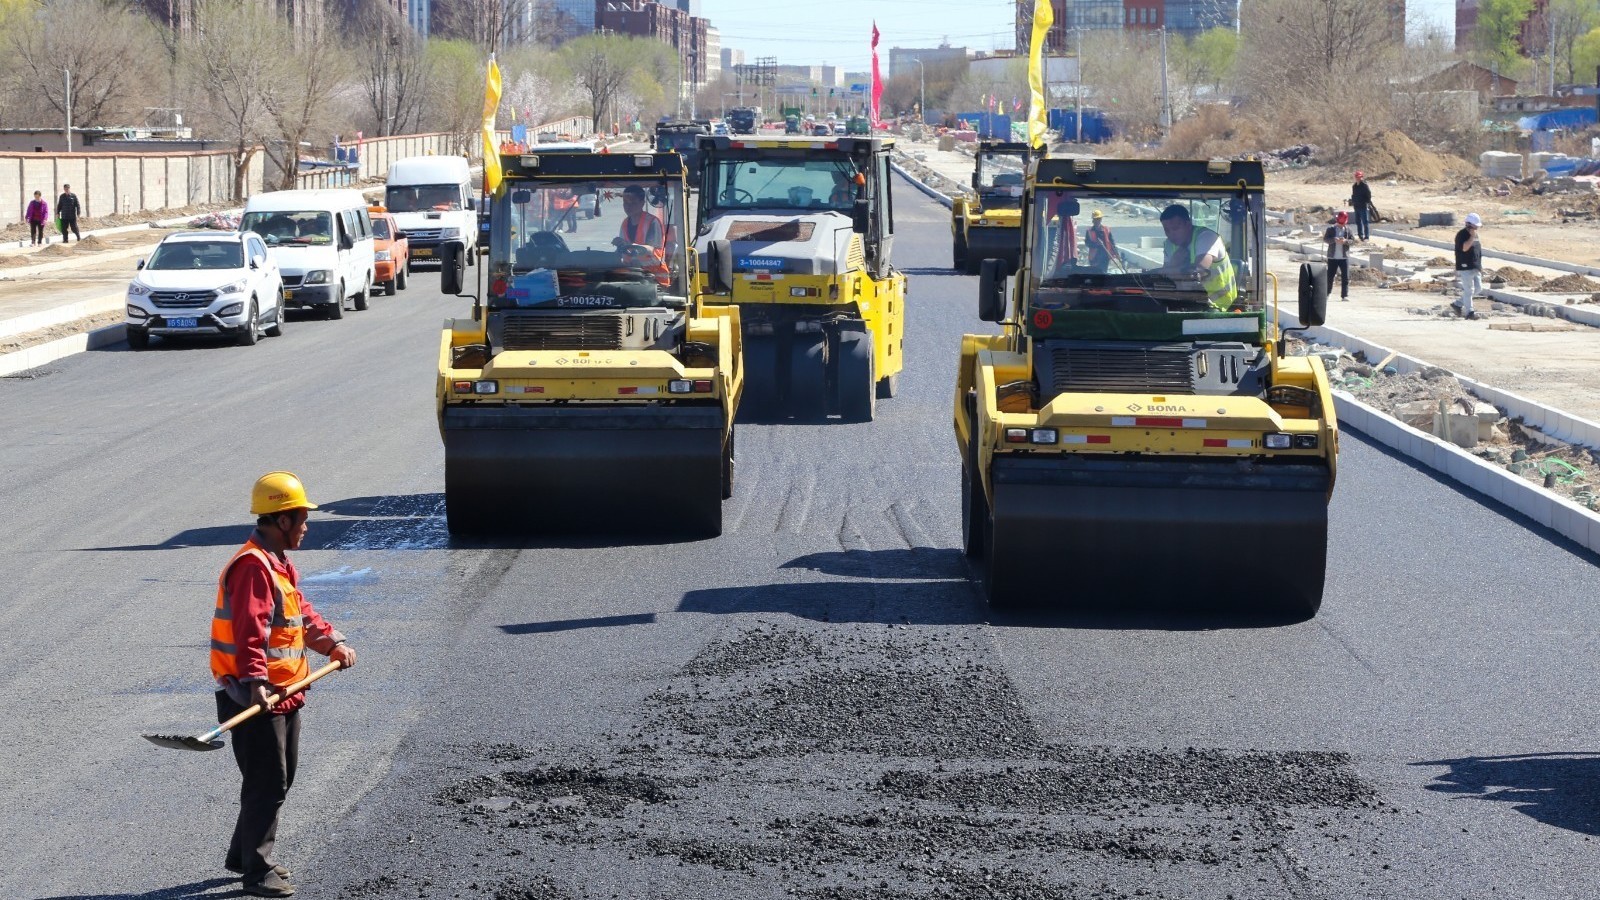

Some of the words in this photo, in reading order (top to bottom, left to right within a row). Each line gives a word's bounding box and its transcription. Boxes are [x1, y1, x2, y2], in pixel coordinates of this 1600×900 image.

[739, 259, 782, 267] 3-10044847
[558, 296, 612, 306] 3-10012473
[1036, 313, 1050, 325] 50
